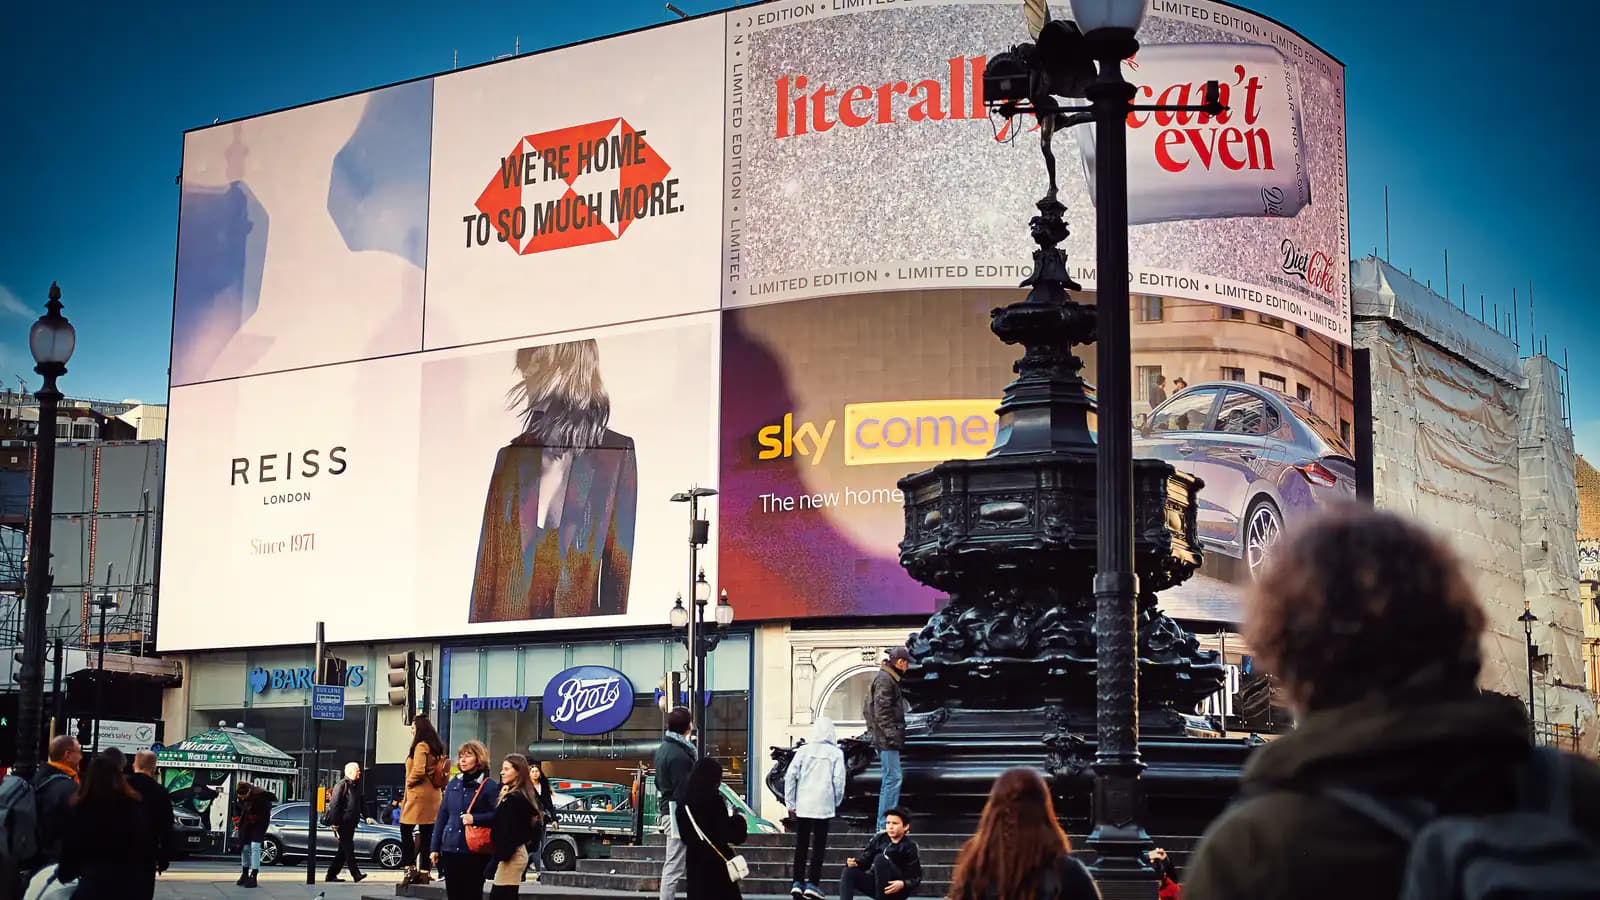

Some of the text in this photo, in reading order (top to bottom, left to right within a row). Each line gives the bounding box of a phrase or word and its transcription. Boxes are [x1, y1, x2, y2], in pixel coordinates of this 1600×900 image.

[758, 4, 814, 25] EDITION
[1153, 0, 1332, 76] LIMITED EDITION LIMITED EDITION
[732, 63, 743, 128] LIMITED
[775, 54, 1040, 142] literall
[1284, 70, 1294, 111] SUGAR
[1291, 126, 1298, 148] NO
[501, 130, 647, 189] WE'RE HOME
[731, 134, 742, 200] EDITION
[1154, 127, 1276, 173] even
[463, 178, 684, 248] TO SO MUCH MORE.
[1281, 238, 1308, 281] Diet
[1307, 251, 1334, 293] Coke
[750, 277, 808, 296] LIMITED
[814, 270, 877, 287] EDITION
[898, 265, 968, 280] LIMITED
[975, 265, 1033, 278] EDITIO
[1140, 272, 1199, 291] EDITION
[1215, 283, 1263, 303] LIMITED
[1266, 294, 1302, 317] EDITION
[1309, 310, 1337, 331] LIMITED
[758, 412, 999, 465] sky come
[231, 446, 347, 486] REISS
[263, 492, 311, 505] LONDON
[759, 486, 904, 513] The new home
[250, 533, 315, 556] Since 1971
[452, 693, 529, 713] pharmacy
[551, 678, 620, 723] Boots
[555, 813, 598, 825] ONWAY
